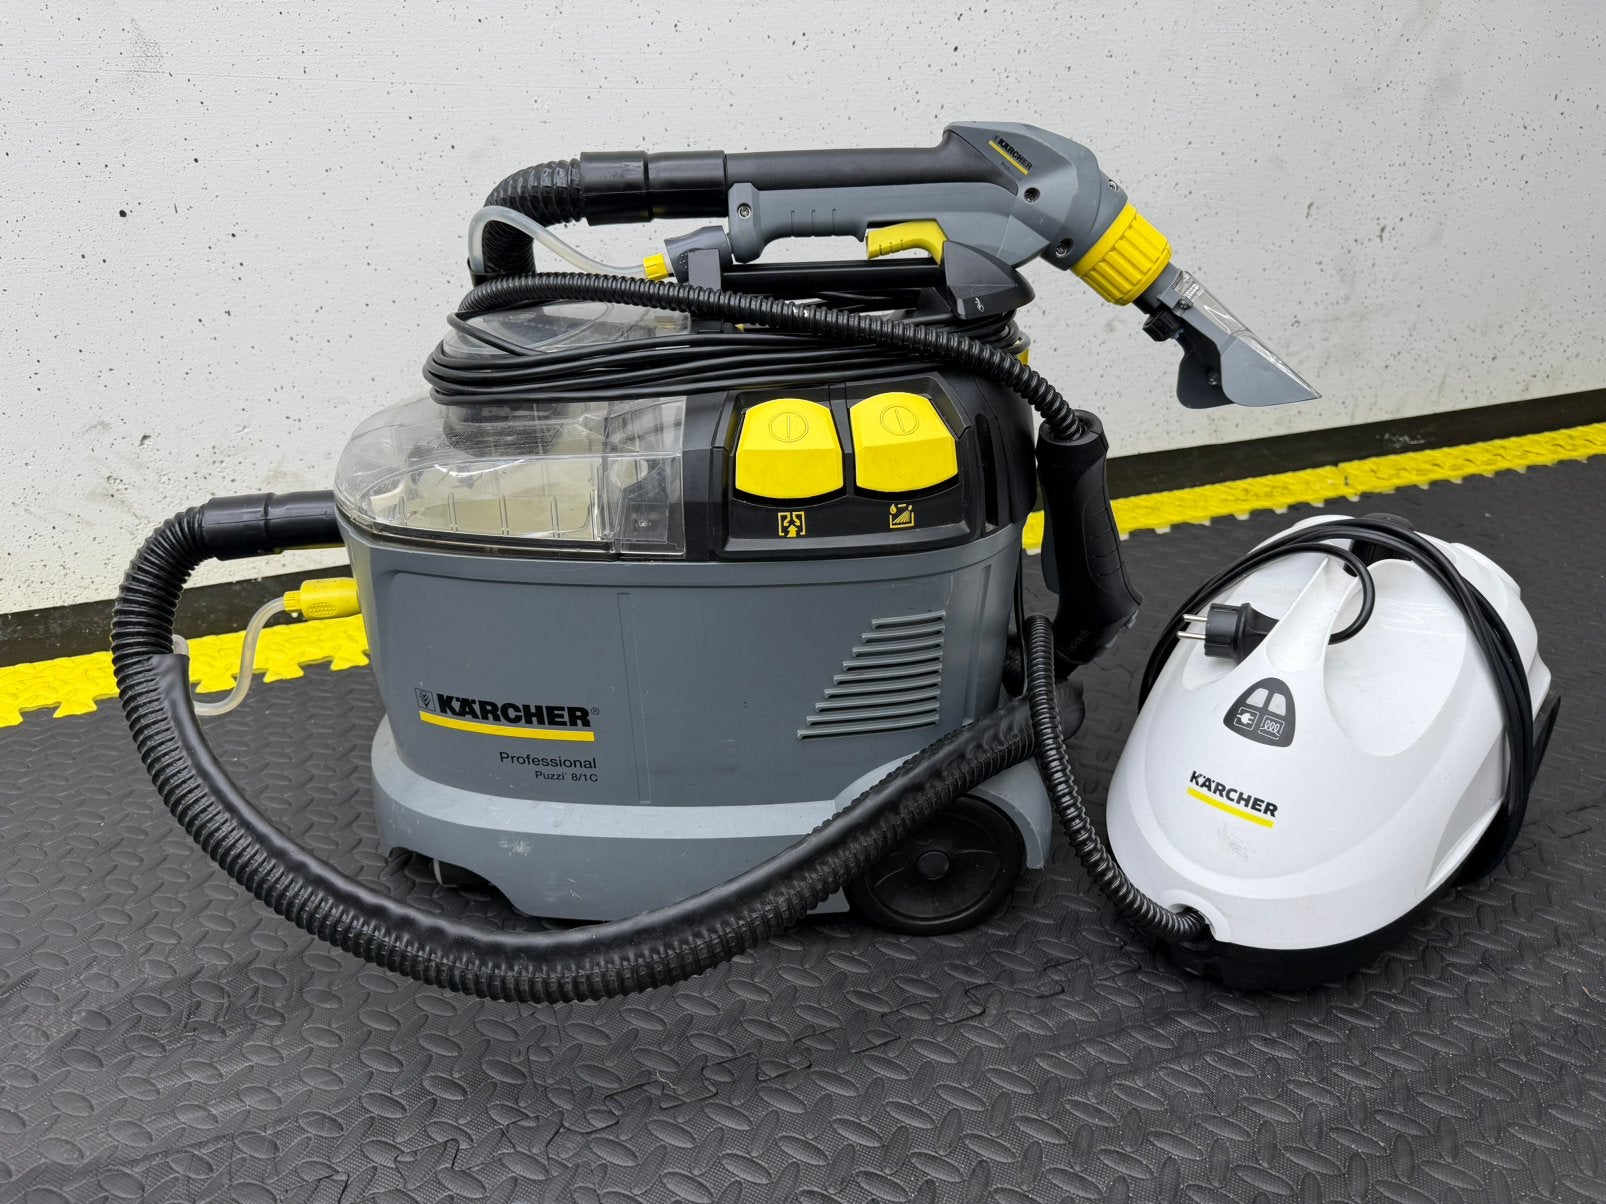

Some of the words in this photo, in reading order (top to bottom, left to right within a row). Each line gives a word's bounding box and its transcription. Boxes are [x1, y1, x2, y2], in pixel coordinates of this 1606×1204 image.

[499, 751, 597, 769] Professional
[535, 770, 565, 781] Puzzi
[571, 773, 598, 782] 8/1C
[1189, 770, 1278, 818] KÄRCHER
